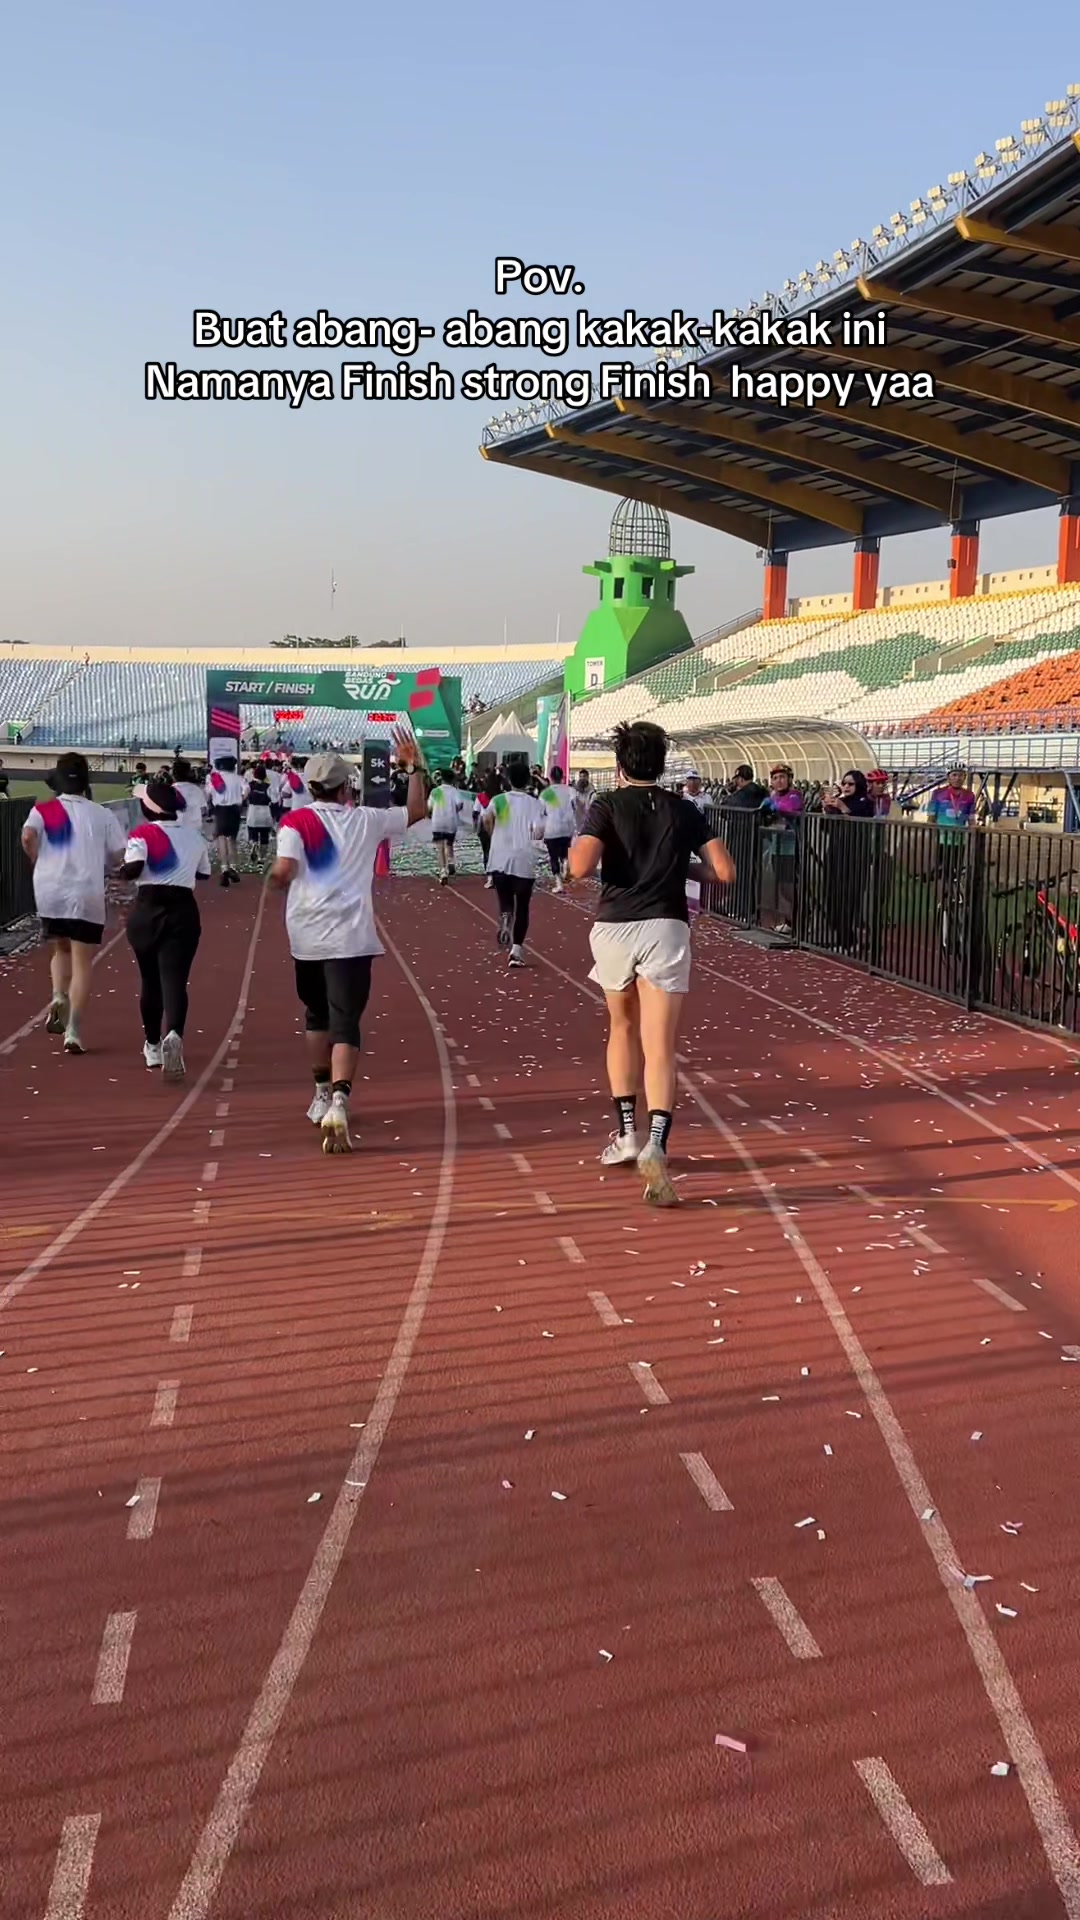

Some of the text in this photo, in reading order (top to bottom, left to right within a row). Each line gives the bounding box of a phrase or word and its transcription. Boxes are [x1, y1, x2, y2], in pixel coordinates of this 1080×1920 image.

[591, 674, 598, 686] D
[225, 681, 265, 693] START
[274, 683, 315, 694] FINISH
[343, 683, 392, 700] RUN
